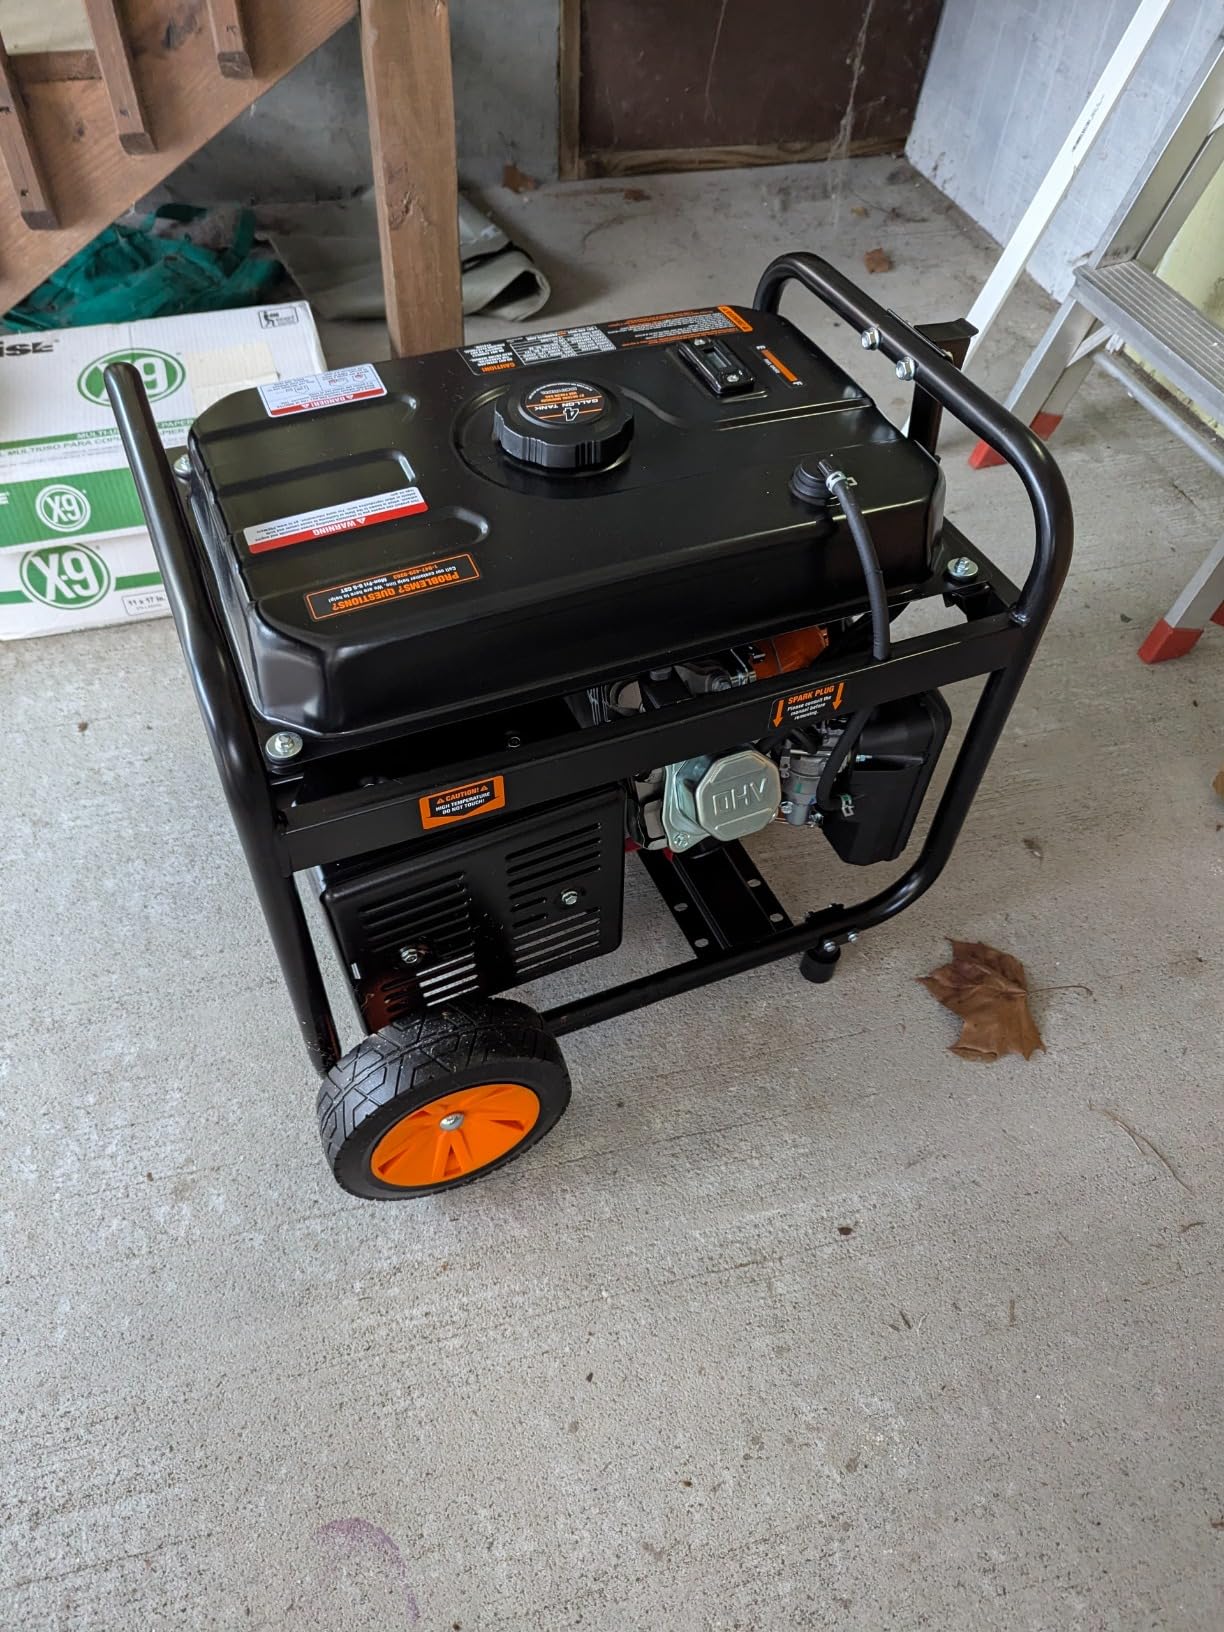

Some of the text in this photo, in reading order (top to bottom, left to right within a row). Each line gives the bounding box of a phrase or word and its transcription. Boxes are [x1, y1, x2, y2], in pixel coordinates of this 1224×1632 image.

[311, 397, 345, 408] DANGER!
[562, 399, 598, 408] GALLON
[563, 407, 579, 421] 4
[312, 522, 357, 536] WARNING
[410, 571, 435, 580] customer
[332, 571, 460, 611] PROBLEMS? QUESTIONS?
[788, 685, 835, 705] SPARK PLUG
[435, 791, 490, 811] HIGH TEMPERATURE
[445, 786, 480, 802] CAUTION!
[712, 777, 768, 816] OHV
[464, 799, 485, 808] TOUCH!
